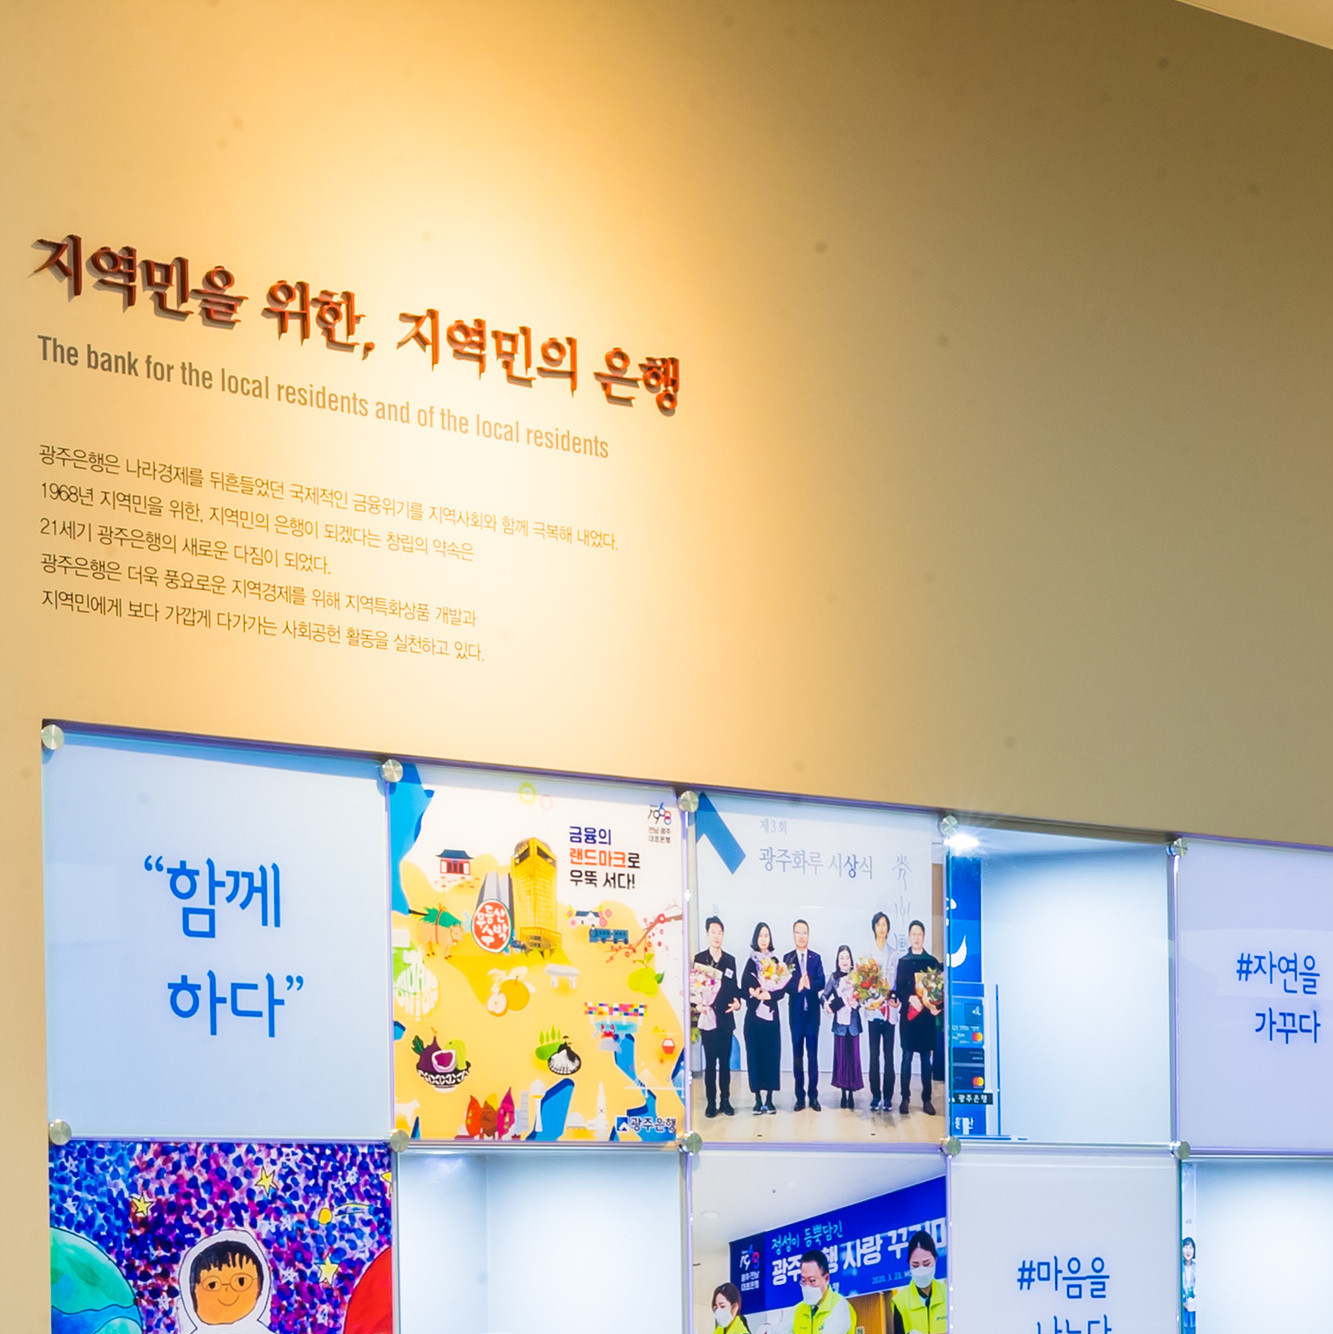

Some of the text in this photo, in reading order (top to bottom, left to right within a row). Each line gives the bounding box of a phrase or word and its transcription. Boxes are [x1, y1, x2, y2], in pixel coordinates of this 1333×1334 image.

[29, 234, 681, 417] 지역민을 위한, 지역민의 은행
[37, 334, 609, 459] The bank for the local residents and of the local residents
[39, 444, 618, 551] 광주은행은 나라경제를 뒤흔들었던 국제적인 금융위기를 지역사회와 함께 극복해 내었다.
[41, 482, 94, 507] 1968년
[101, 490, 163, 517] 지역민을
[209, 505, 270, 532] 지역민의
[274, 515, 318, 539] 은행이
[324, 523, 382, 548] 되겠다는
[386, 531, 429, 555] 창립의
[432, 538, 475, 562] 약속은
[40, 517, 331, 575] 21세기 광주은행의 새로운 다짐이 되었다.
[40, 552, 476, 627] 광주은행은 더욱 풍요로운 지역경제를 위해 지역특화상품 개발과
[42, 590, 485, 662] 지역민에게 보다 가깝게 다가가는 사회공헌 활동을 실천하고 있다.
[569, 826, 611, 845] 금융의
[760, 819, 787, 834] 제3회
[569, 848, 641, 869] 랜드마크로
[570, 869, 635, 889] 우뚝 서다!
[759, 847, 873, 879] 광주화루 시상식
[1236, 951, 1321, 995] #자연을
[1254, 1007, 1321, 1044] 가꾸다
[631, 1117, 676, 1135] 광주은행
[772, 1245, 838, 1286] 광주행
[843, 1235, 882, 1270] 사랑
[1017, 1256, 1110, 1300] #마음을
